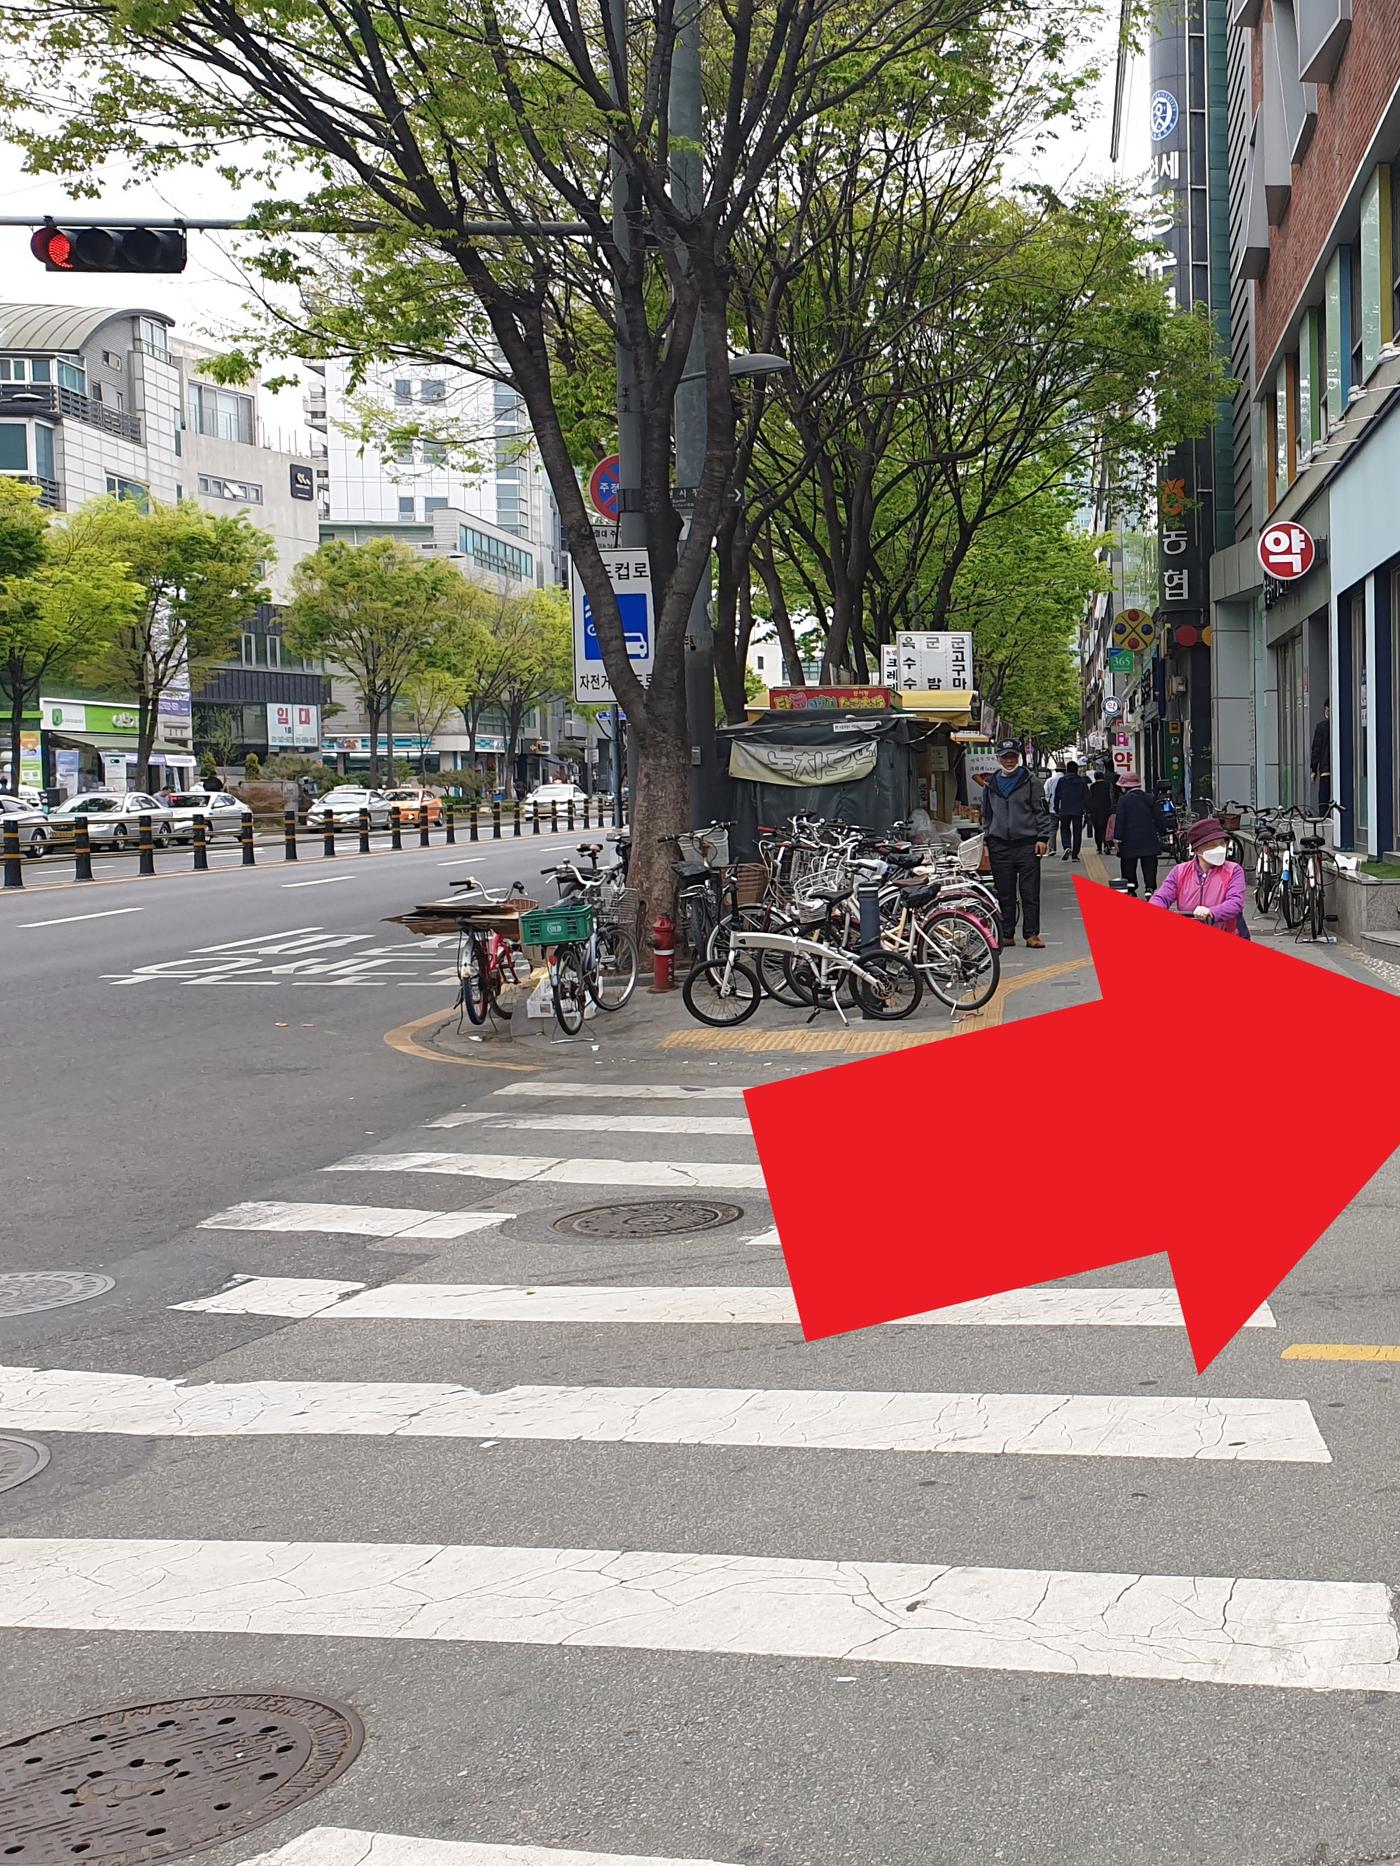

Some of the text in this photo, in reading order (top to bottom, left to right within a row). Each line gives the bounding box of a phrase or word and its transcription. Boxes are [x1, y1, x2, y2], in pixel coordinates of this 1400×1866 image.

[1264, 528, 1306, 573] 약
[951, 637, 967, 690] 군고구마
[1114, 656, 1131, 667] 365
[1114, 751, 1133, 771] 약
